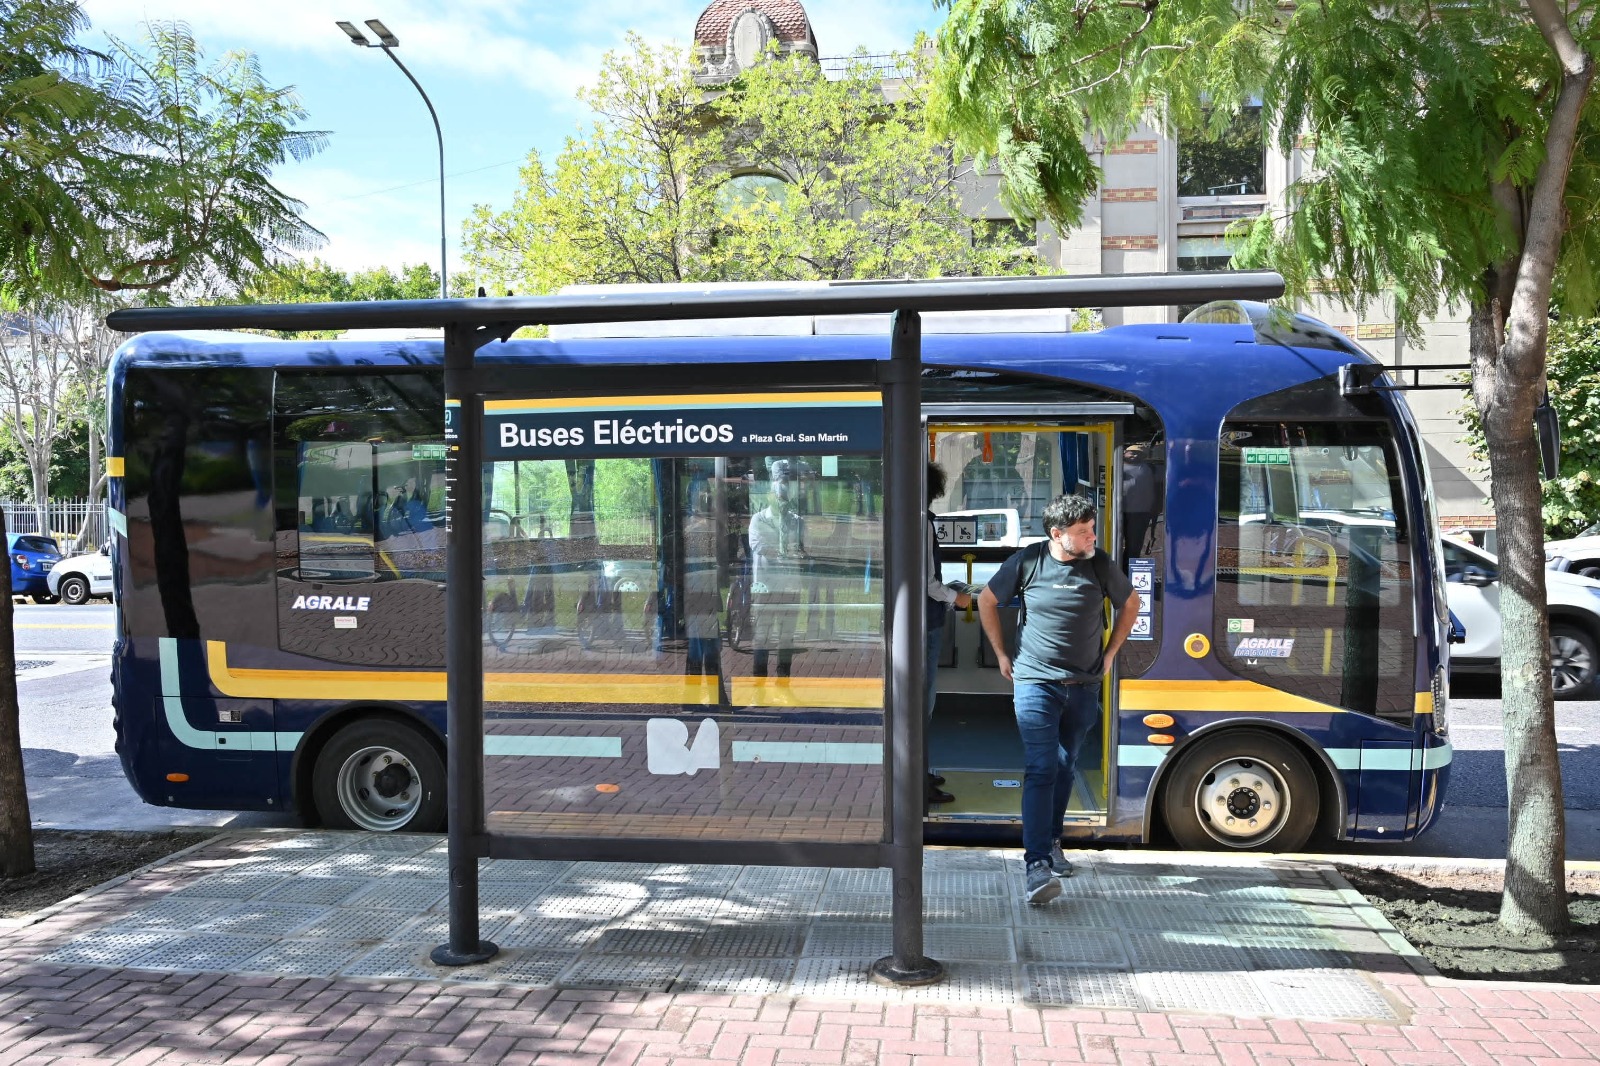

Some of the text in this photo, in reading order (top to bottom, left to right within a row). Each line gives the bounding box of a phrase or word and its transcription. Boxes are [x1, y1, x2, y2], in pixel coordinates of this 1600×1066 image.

[500, 422, 585, 447] Buses
[594, 418, 734, 445] Eléctricos
[749, 434, 773, 443] Plaza
[774, 433, 796, 443] Gral.
[798, 433, 816, 442] San
[818, 432, 849, 442] Martín
[291, 595, 371, 611] AGRALE
[1239, 638, 1295, 648] AGRALE
